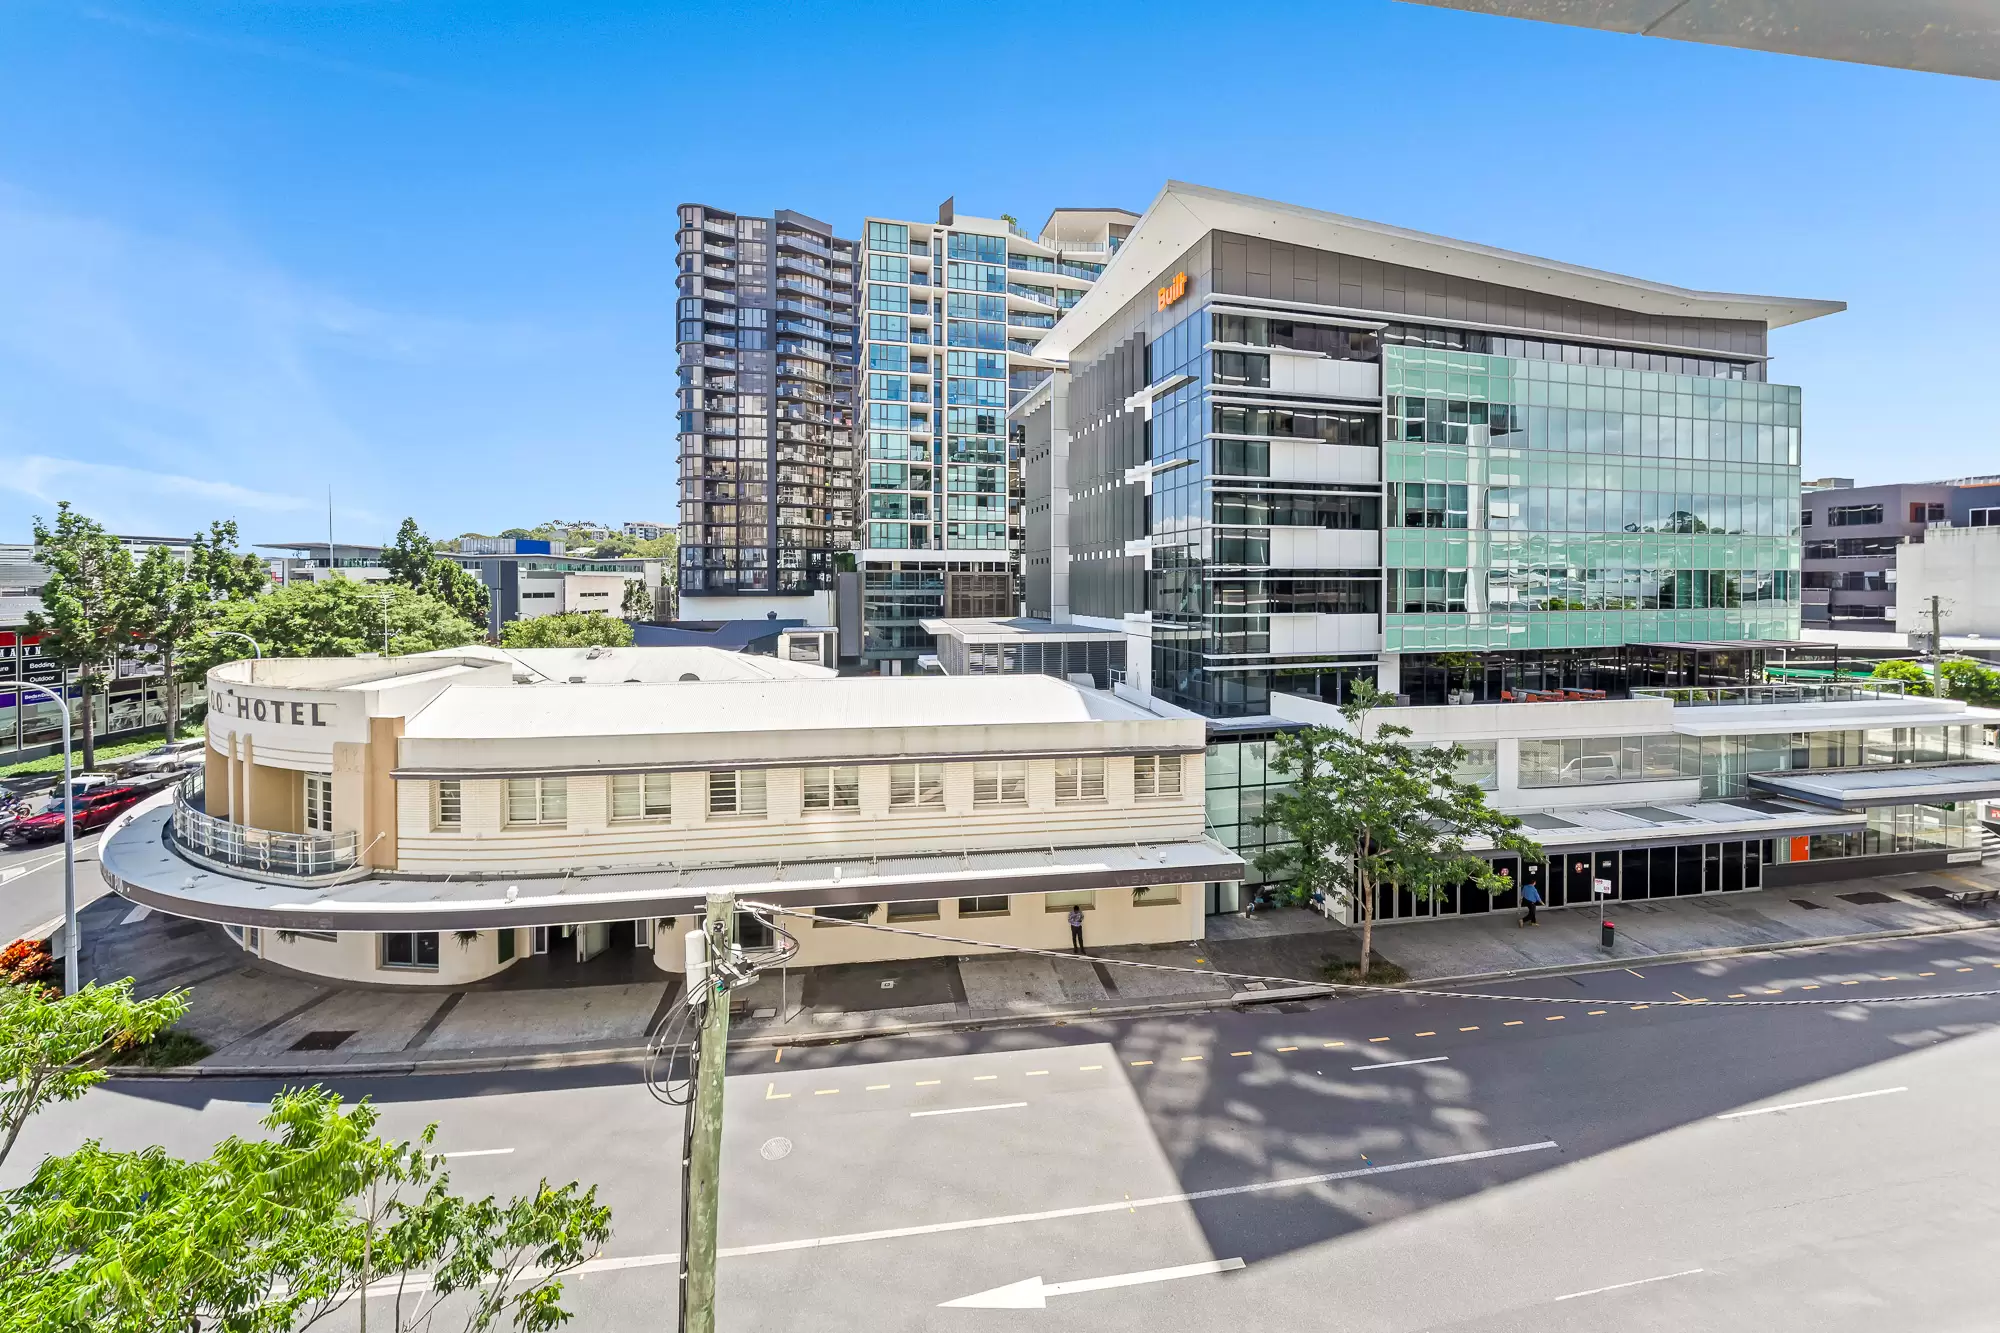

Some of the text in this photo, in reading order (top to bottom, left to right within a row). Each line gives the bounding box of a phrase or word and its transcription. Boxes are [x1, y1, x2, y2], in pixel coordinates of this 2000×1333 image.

[1157, 271, 1187, 312] Built
[29, 661, 55, 669] Bedding
[29, 675, 55, 683] Outdoor
[237, 696, 326, 726] HOTEL
